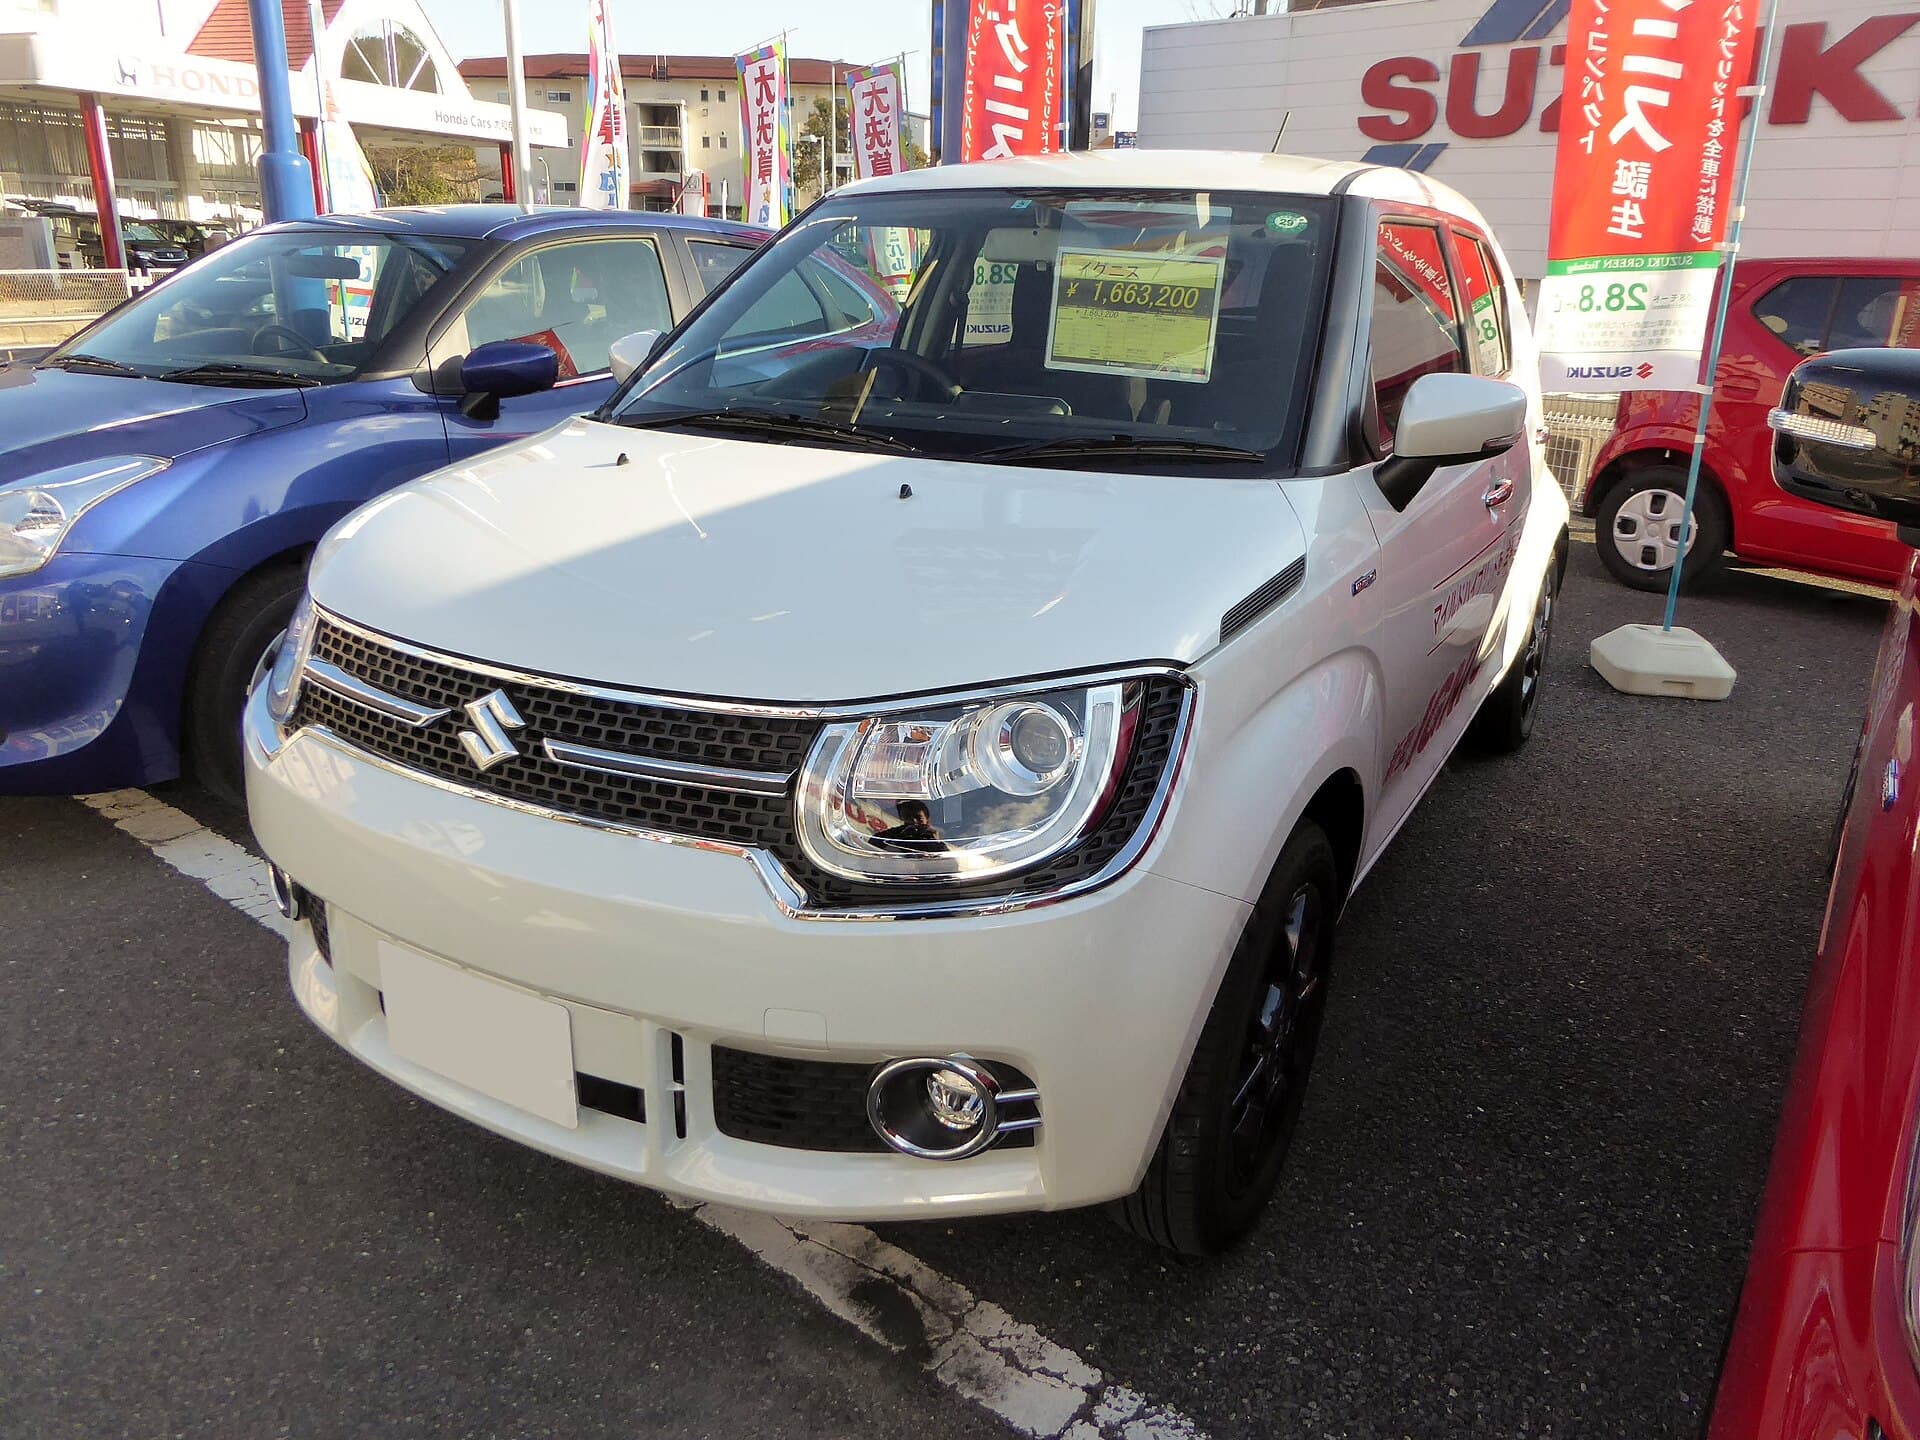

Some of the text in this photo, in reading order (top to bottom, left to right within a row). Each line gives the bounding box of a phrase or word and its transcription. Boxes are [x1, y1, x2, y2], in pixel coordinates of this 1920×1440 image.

[151, 64, 258, 97] HOND
[1358, 12, 1920, 141] SUK
[435, 110, 468, 126] Honda
[471, 115, 492, 129] Cars
[1079, 261, 1139, 280] イグニス
[1066, 281, 1200, 309] ¥ 1,663,200
